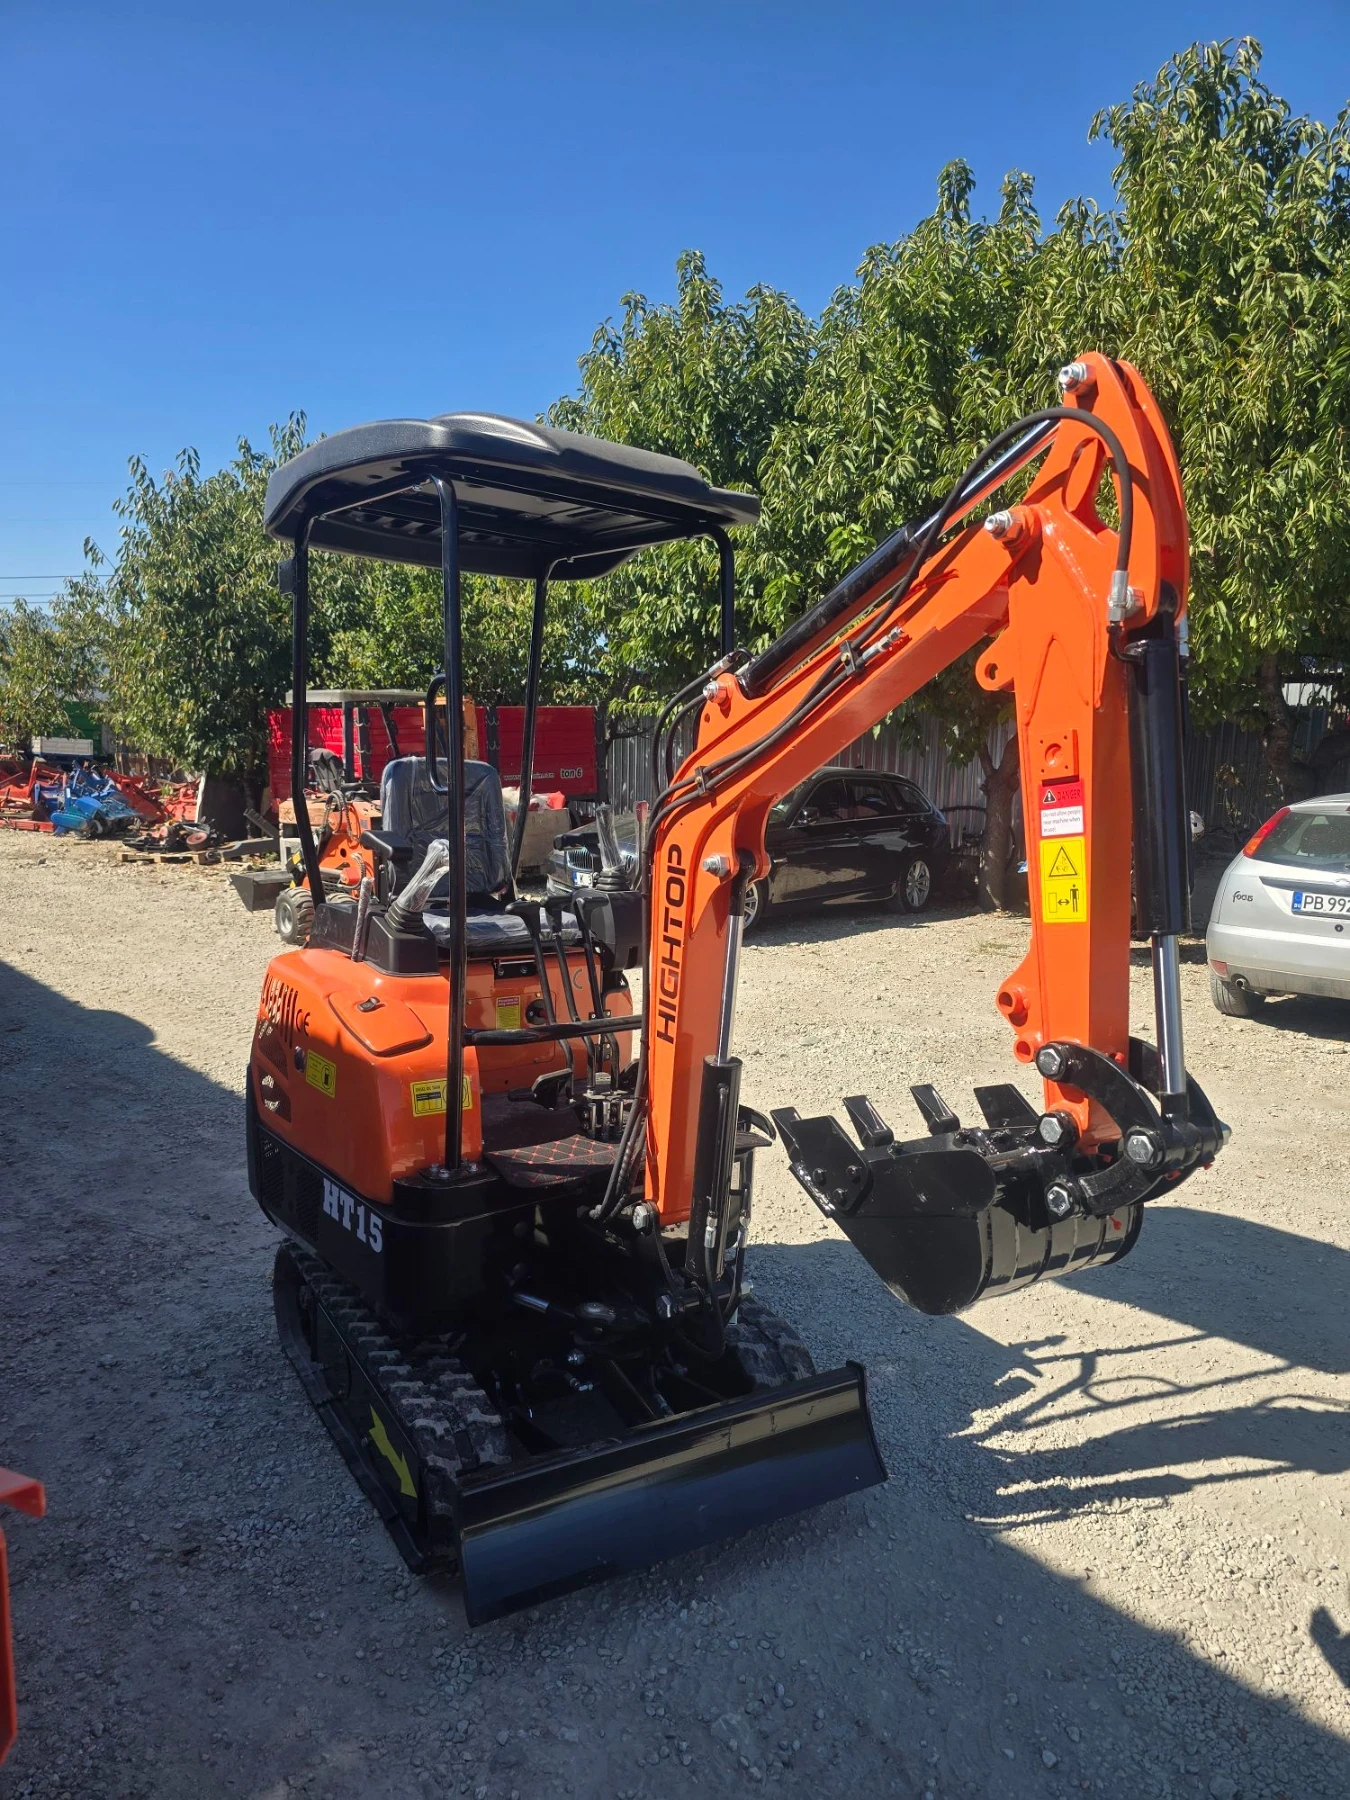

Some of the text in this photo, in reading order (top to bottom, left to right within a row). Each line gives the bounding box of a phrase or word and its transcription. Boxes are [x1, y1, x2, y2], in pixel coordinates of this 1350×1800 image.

[560, 768, 575, 779] ton
[576, 767, 583, 778] 6
[1057, 789, 1080, 801] DANGER
[1303, 895, 1324, 910] PB
[656, 843, 686, 1045] HIGHTOP
[296, 1009, 310, 1037] CE
[323, 1177, 383, 1253] HT15
